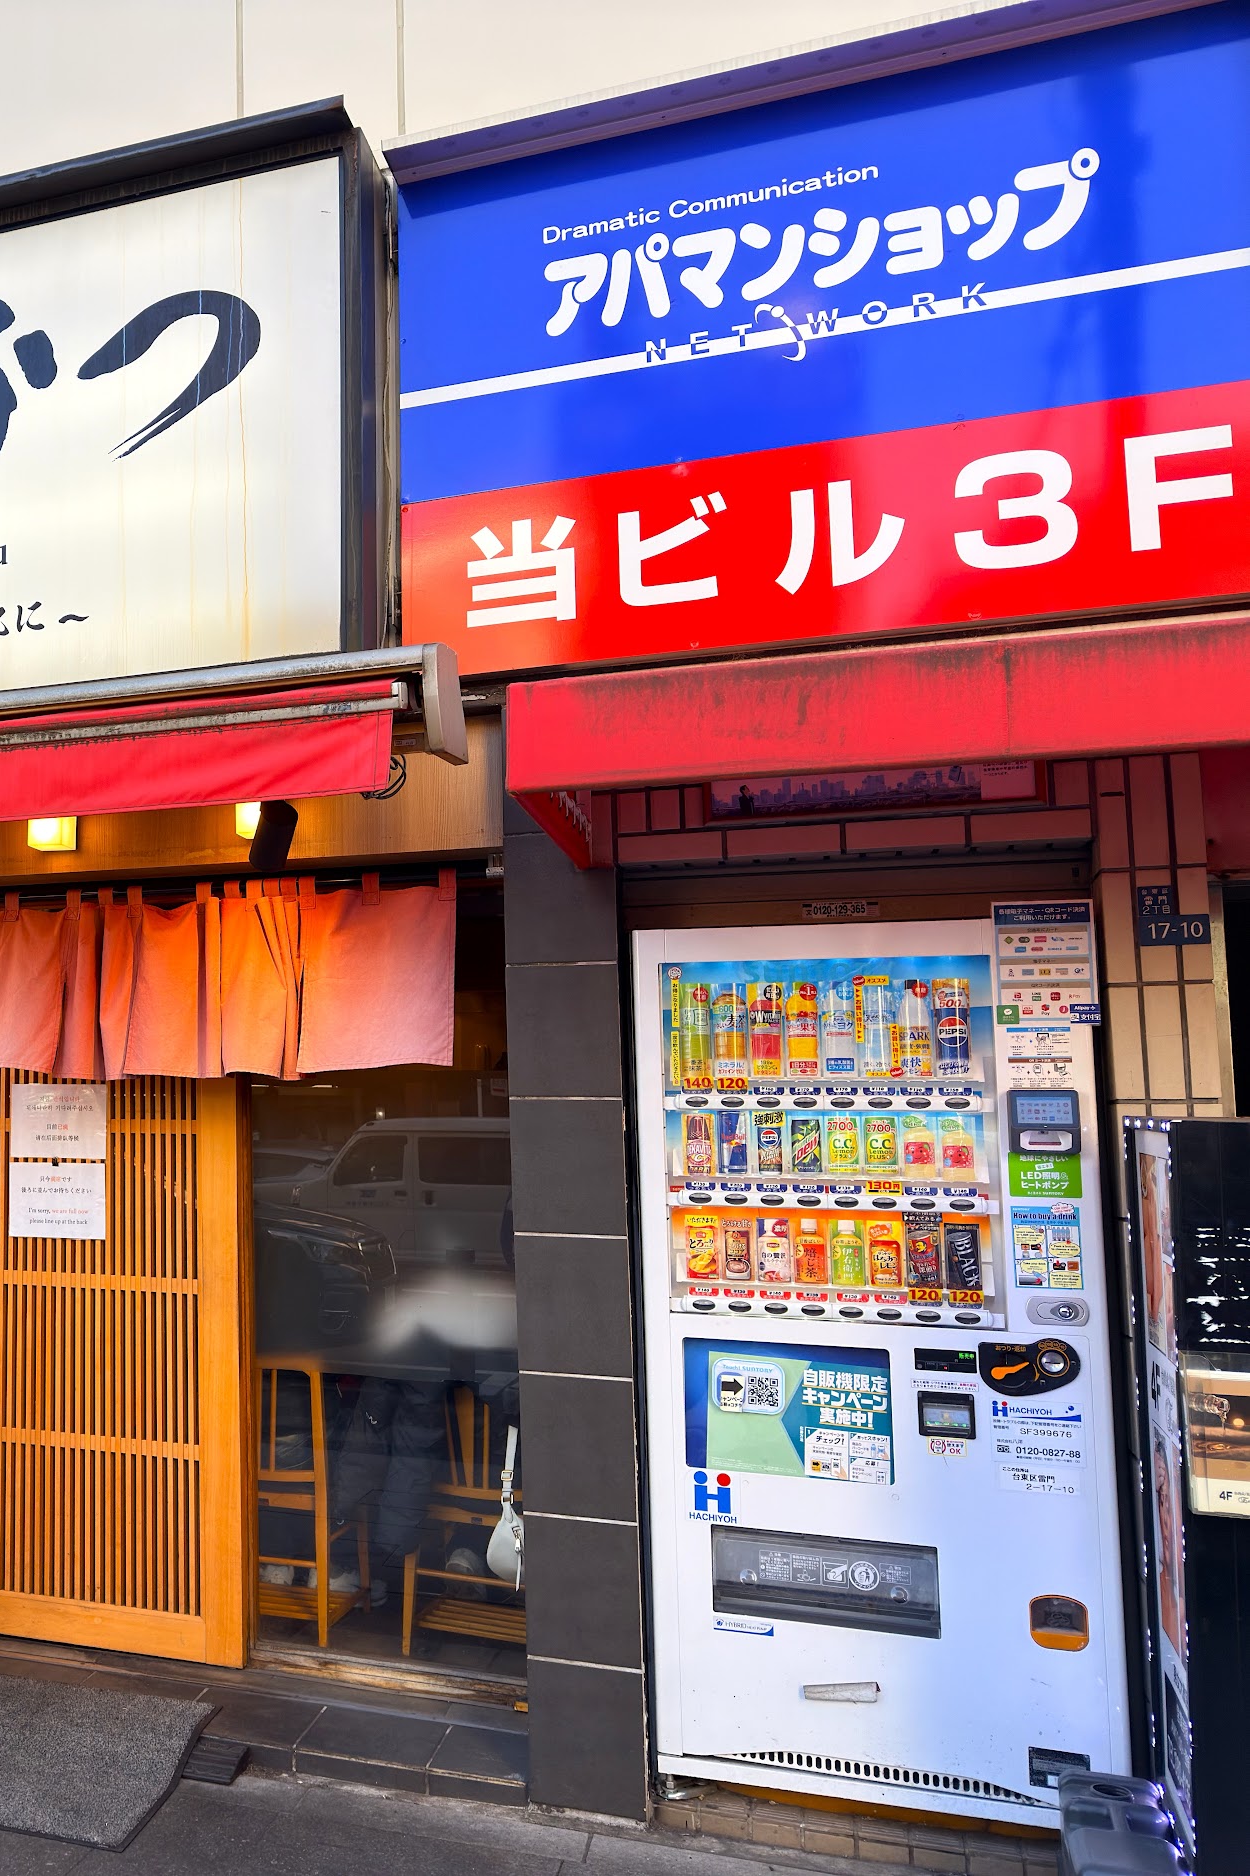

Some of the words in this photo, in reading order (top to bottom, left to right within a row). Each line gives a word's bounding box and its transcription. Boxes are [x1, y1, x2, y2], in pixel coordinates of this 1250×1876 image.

[542, 210, 661, 245] Dramatic
[668, 162, 879, 219] Communication
[545, 146, 1100, 337] アパマンショップ
[1143, 905, 1170, 914] 2丁目
[1148, 922, 1203, 939] 17-10
[1021, 1181, 1069, 1190] ヒートポンプ
[954, 1240, 980, 1287] BLACK
[802, 1369, 888, 1393] 自販機限定
[802, 1388, 888, 1411] キャンペーン
[1009, 1407, 1052, 1415] HACHIYOH
[820, 1412, 874, 1427] 実施中!
[816, 1436, 844, 1445] チェック!
[1016, 1446, 1081, 1458] 0120-0827-88
[1012, 1473, 1055, 1483] 台東区雷門
[1219, 1491, 1232, 1500] 4F
[689, 1512, 737, 1524] HACHIYOH
